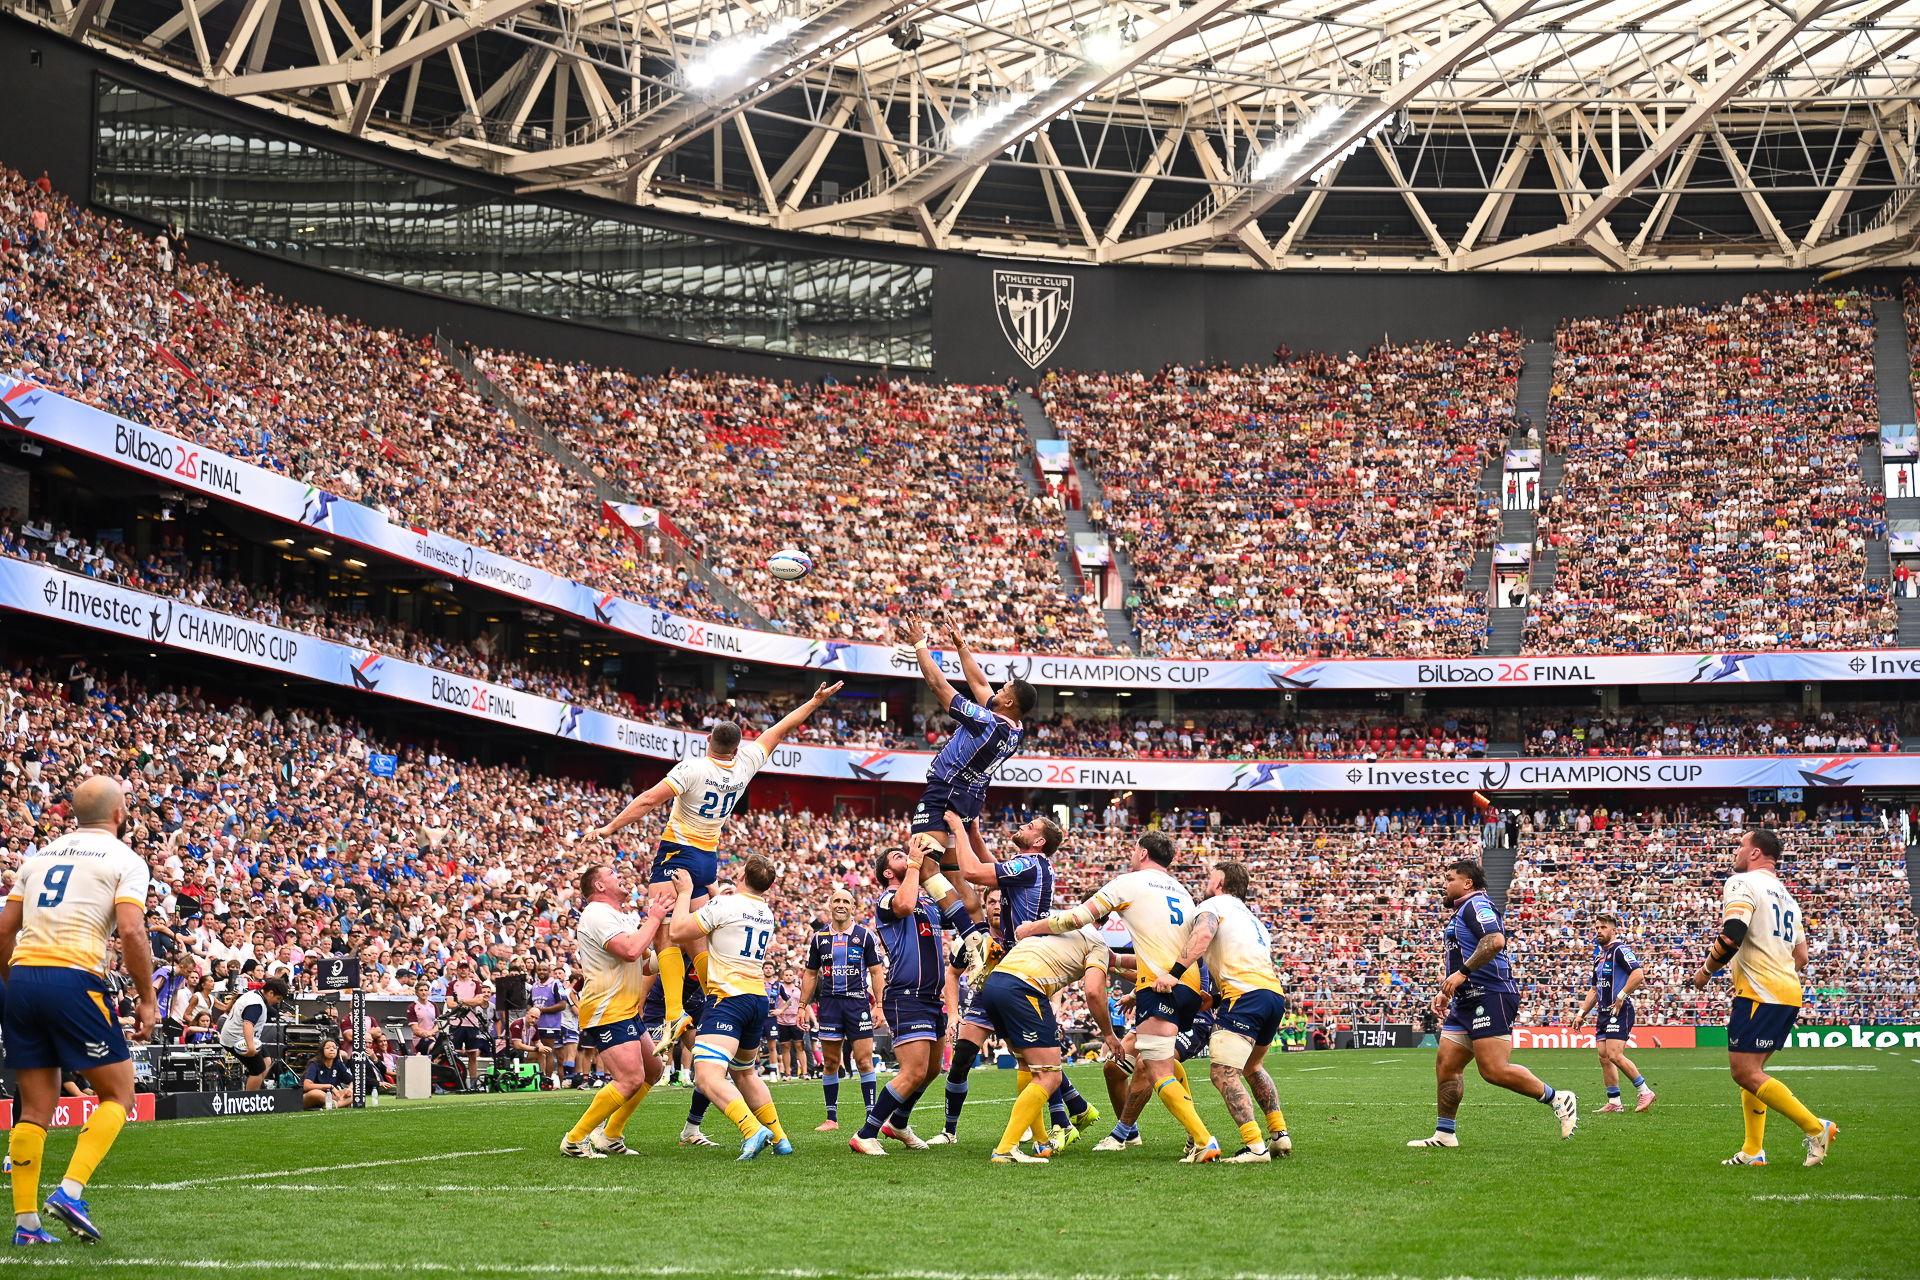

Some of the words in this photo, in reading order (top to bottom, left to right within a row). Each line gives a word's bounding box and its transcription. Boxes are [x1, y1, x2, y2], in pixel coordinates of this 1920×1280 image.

[999, 274, 1042, 285] ATHLETIC
[1044, 277, 1069, 287] CLUB
[1017, 337, 1051, 364] BILBAO
[115, 423, 173, 470] Bilbao
[174, 445, 198, 480] 26
[200, 459, 242, 495] FINAL
[424, 541, 459, 568] Investec
[475, 561, 516, 588] CHAMPIONS
[517, 575, 532, 591] CUP
[62, 580, 142, 628] Investec
[178, 613, 266, 657] CHAMPIONS
[269, 636, 298, 664] CUP
[687, 624, 704, 646] 26
[706, 631, 742, 653] FINAL
[1041, 662, 1161, 683] CHAMPIONS
[1167, 666, 1210, 683] CUP
[1418, 664, 1494, 683] Bilbao
[1498, 663, 1529, 682] 26
[1534, 665, 1596, 681] FINAL
[432, 675, 470, 707] Bilbao
[471, 685, 488, 712] 26
[488, 695, 517, 719] FINAL
[625, 723, 669, 752] Investec
[771, 749, 802, 768] CUP
[1046, 765, 1076, 784] 26
[1080, 769, 1137, 785] FINAL
[1368, 766, 1469, 784] Investec
[1519, 765, 1651, 783] CHAMPIONS
[1657, 765, 1702, 782] CUP
[699, 791, 738, 819] 20
[58, 847, 69, 857] of
[69, 847, 106, 859] Ireland
[37, 864, 75, 908] 9
[1165, 895, 1184, 927] 5
[1106, 918, 1125, 932] 26
[1773, 903, 1794, 943] 16
[740, 926, 770, 960] 19
[831, 968, 860, 977] ARKEA
[716, 1021, 733, 1032] laya
[1472, 1016, 1491, 1024] Mano
[1472, 1021, 1491, 1030] Mano
[1359, 1030, 1397, 1047] 73:04
[1513, 1028, 1638, 1048] Emiras
[1755, 1038, 1774, 1048] laya
[1784, 1025, 1920, 1047] neken
[353, 1063, 361, 1097] Investec
[223, 1092, 275, 1115] Investec
